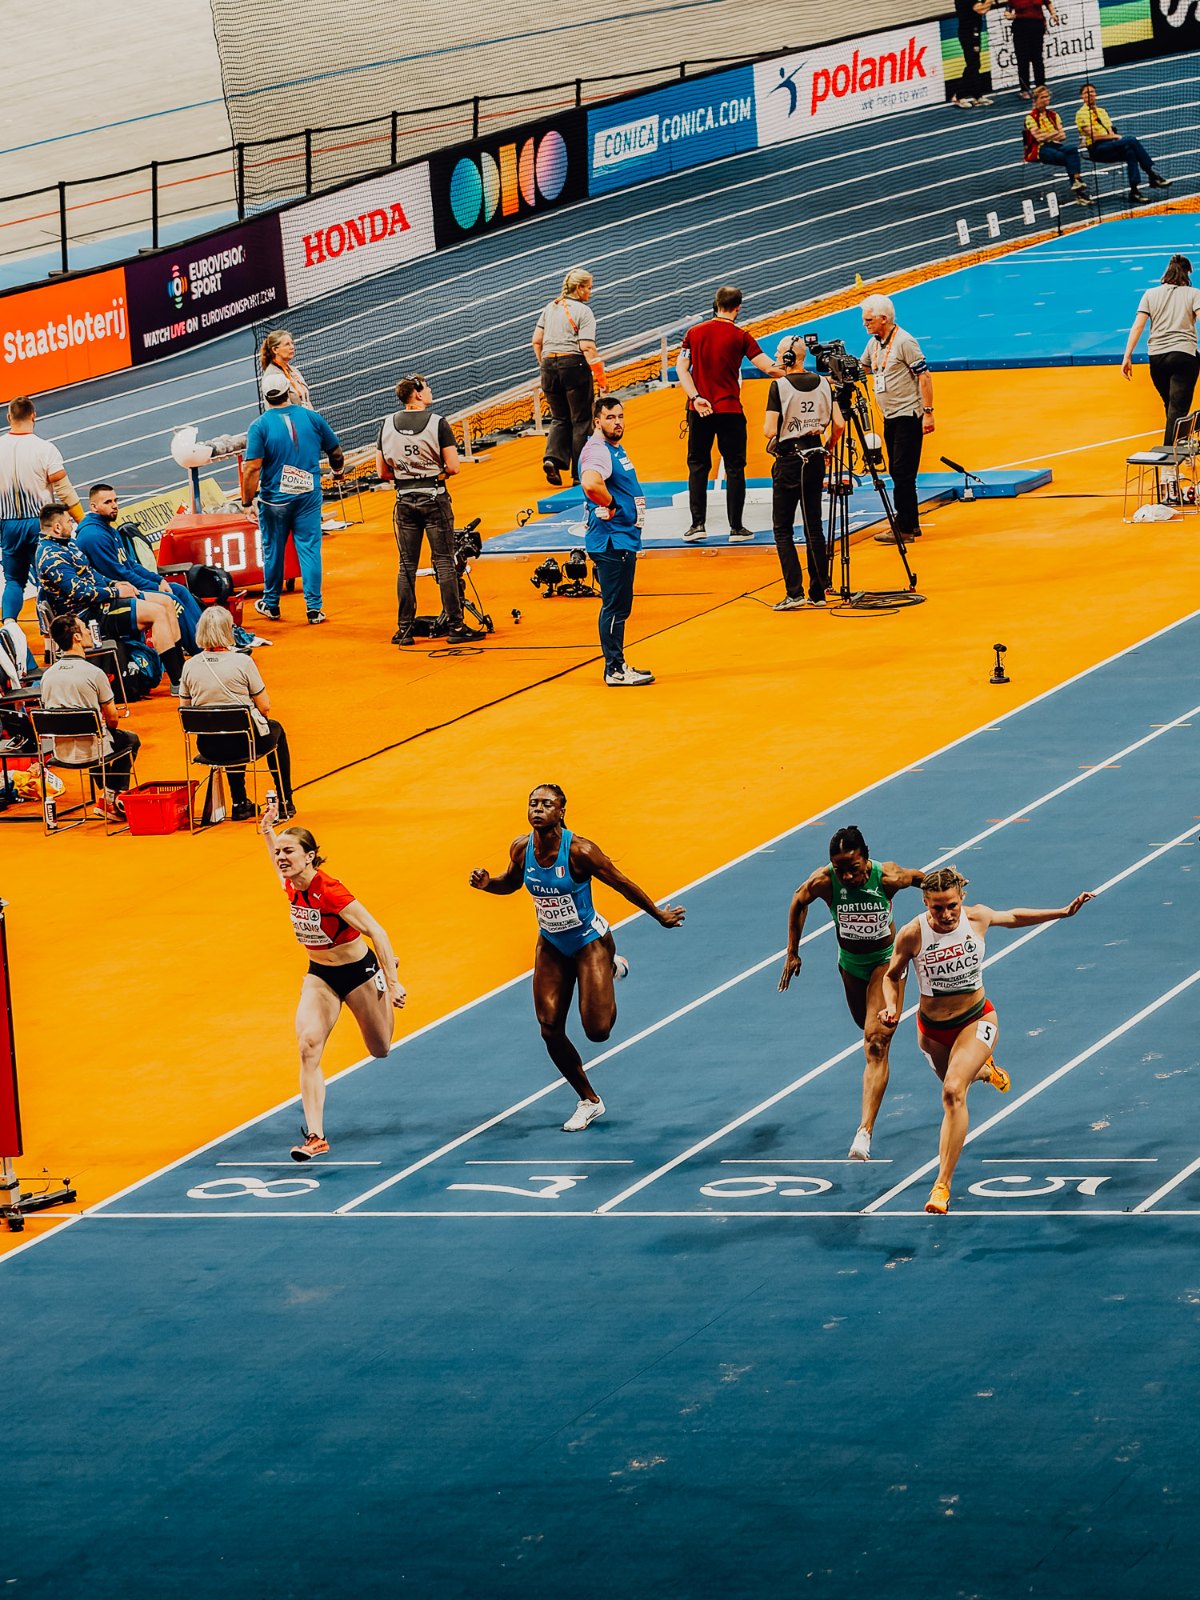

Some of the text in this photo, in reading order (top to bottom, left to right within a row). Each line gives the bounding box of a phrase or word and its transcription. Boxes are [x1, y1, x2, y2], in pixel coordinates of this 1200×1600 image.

[997, 31, 1095, 68] Gerland
[811, 36, 928, 116] polanik
[661, 96, 751, 144] CONICA.COM
[604, 123, 655, 158] CONICA
[303, 202, 411, 267] HONDA
[190, 272, 222, 300] SPORT
[4, 297, 126, 363] Staatsloterij
[143, 326, 170, 348] WATCH
[170, 321, 186, 339] LIVE
[186, 316, 199, 334] ON
[800, 401, 815, 413] 32
[404, 444, 420, 456] 58
[533, 884, 560, 895] ITALIA
[836, 902, 885, 913] PORTUGAL
[840, 914, 877, 922] SPAR
[926, 945, 964, 963] SPAR
[927, 954, 979, 976] TAKÁCS
[984, 1025, 992, 1041] 5
[186, 1177, 321, 1199] 8
[446, 1175, 589, 1199] 7
[968, 1175, 1112, 1198] 5
